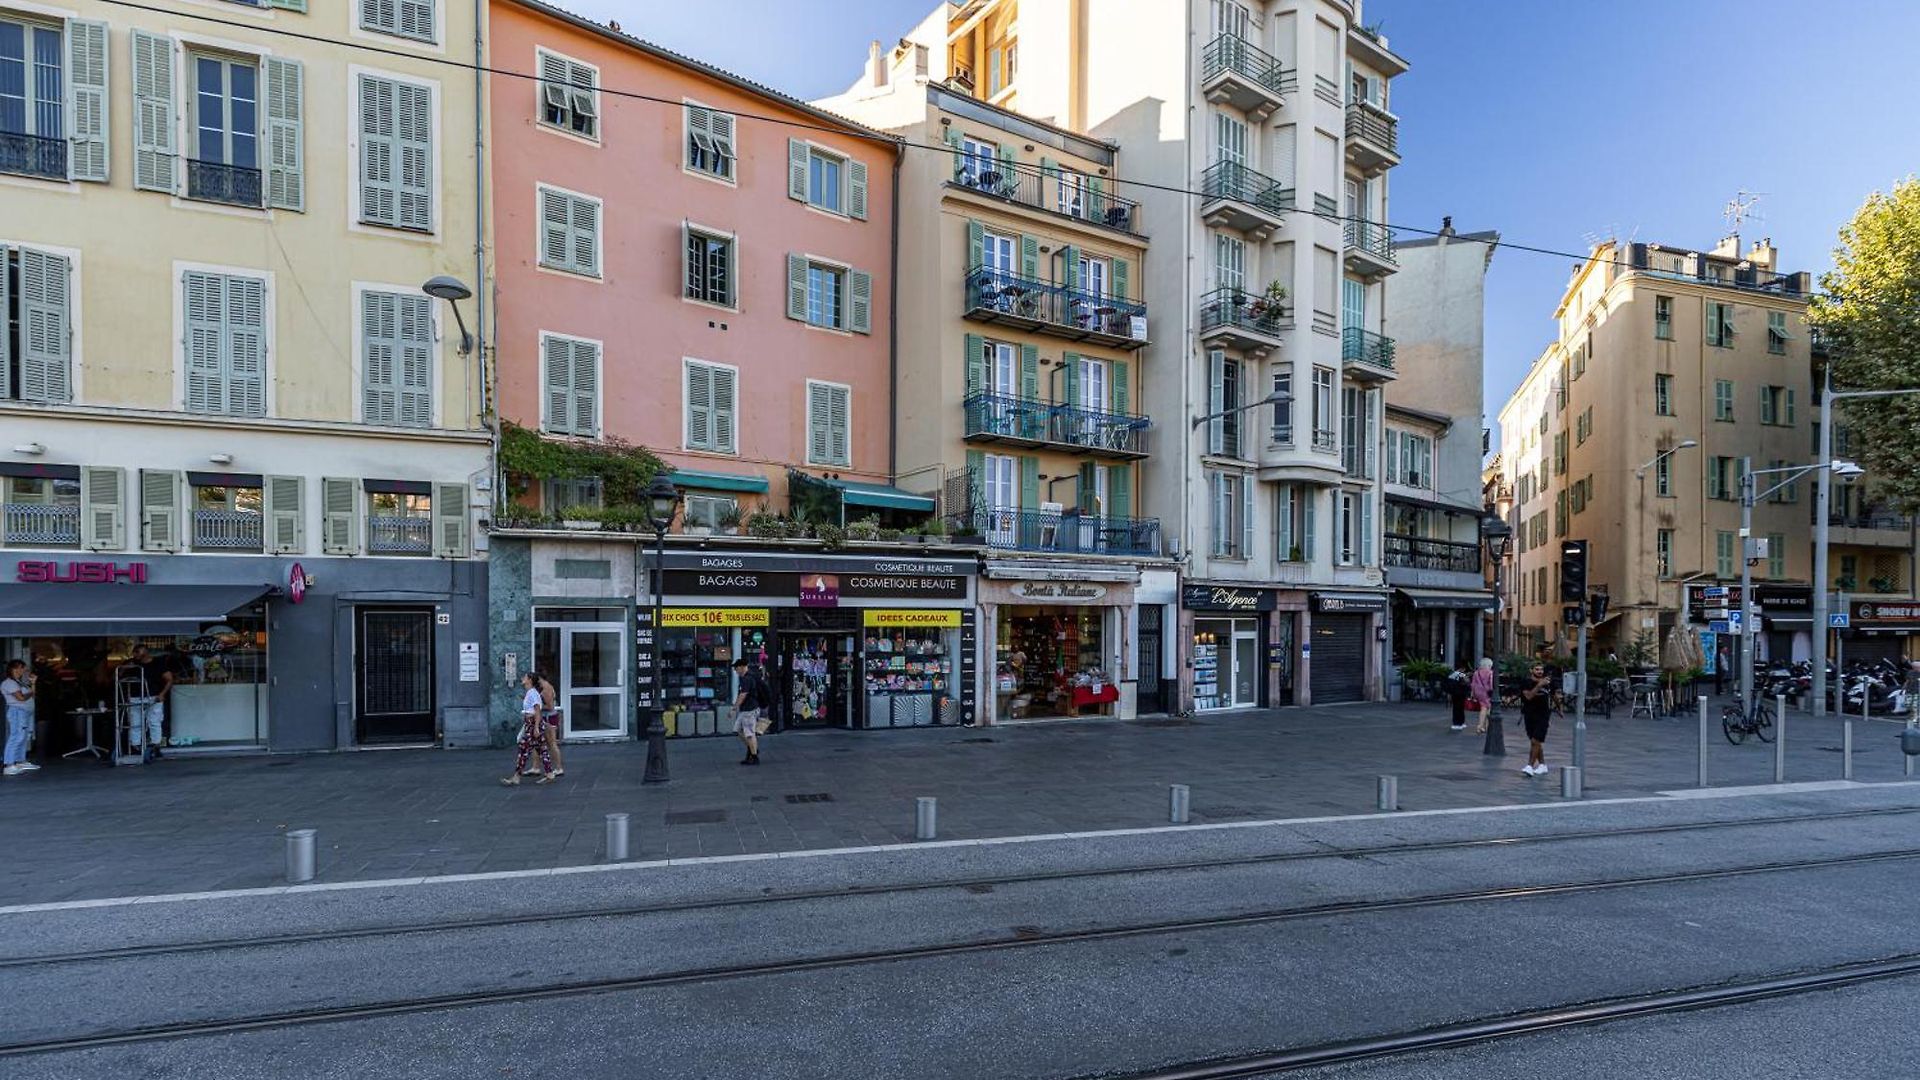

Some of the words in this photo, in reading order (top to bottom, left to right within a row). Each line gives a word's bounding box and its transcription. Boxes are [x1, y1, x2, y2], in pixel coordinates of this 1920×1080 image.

[702, 558, 744, 568] BAGAGES
[875, 563, 925, 573] COSMETIQUE
[17, 561, 147, 583] SUSHI
[699, 575, 758, 587] BAGAGES
[850, 577, 918, 590] COSMETIQUE
[921, 578, 957, 590] BEAUTE
[438, 614, 449, 623] 42
[660, 614, 674, 622] RIX
[675, 613, 700, 622] CHOCS
[702, 611, 723, 624] 10€
[877, 613, 903, 623] IDEES
[905, 613, 949, 623] CADEAUX
